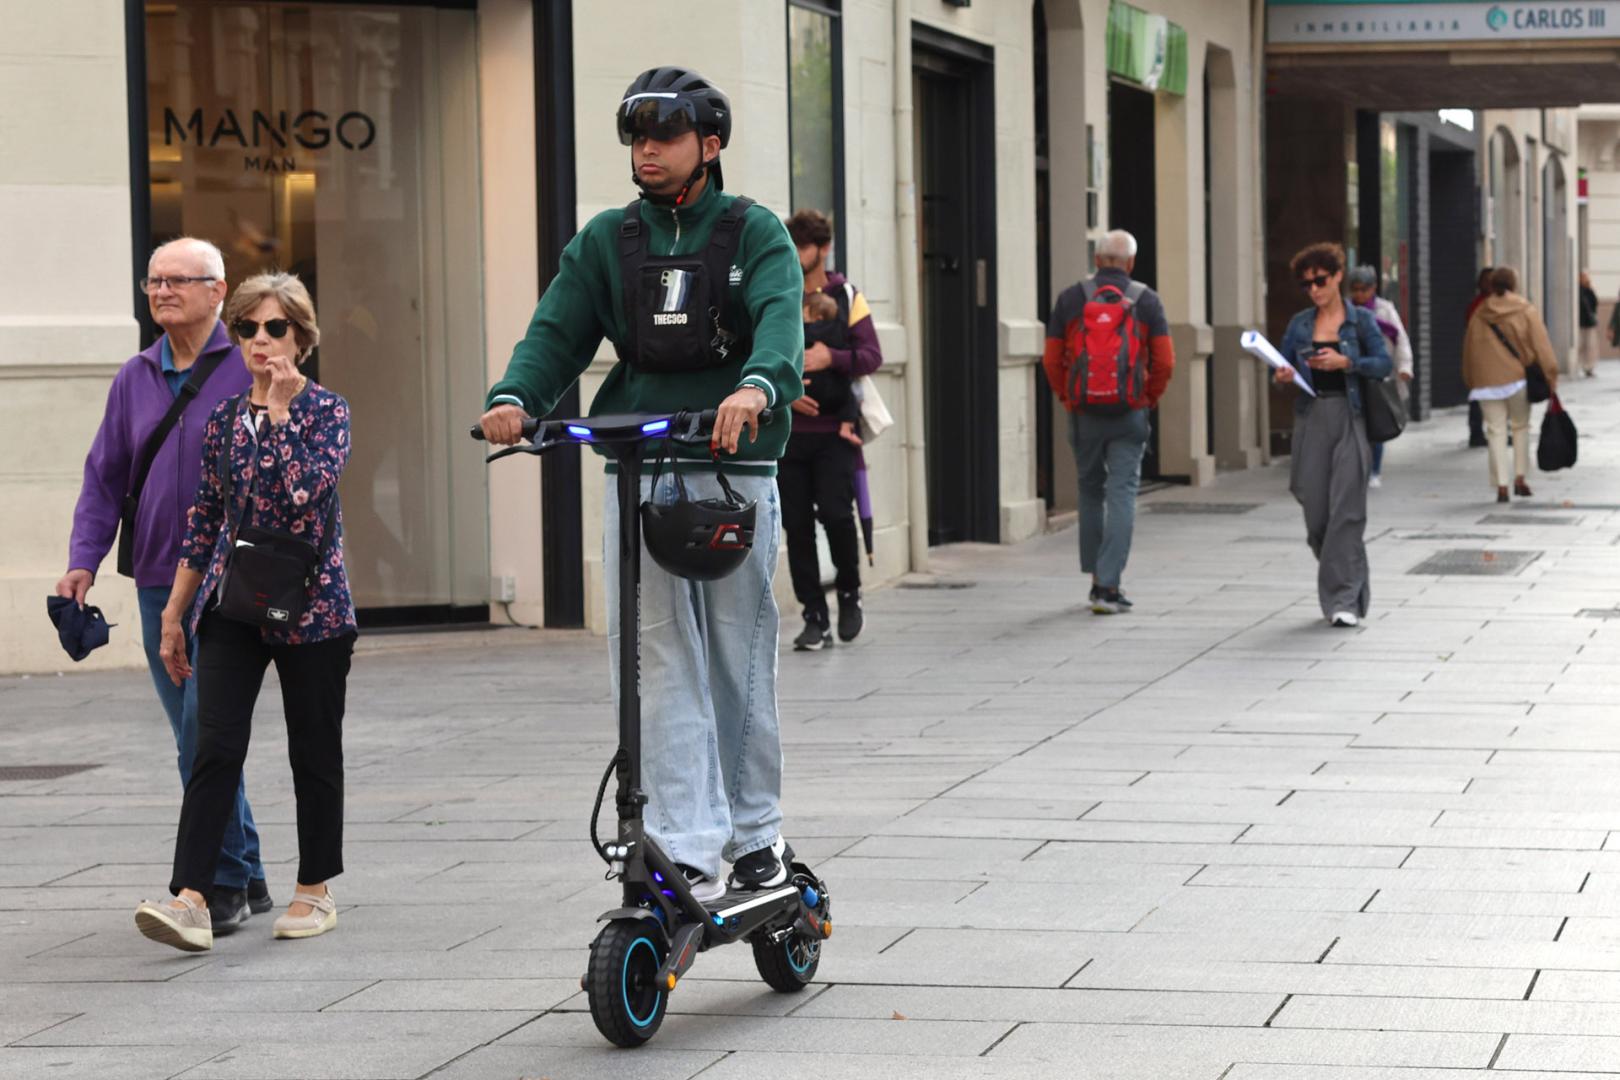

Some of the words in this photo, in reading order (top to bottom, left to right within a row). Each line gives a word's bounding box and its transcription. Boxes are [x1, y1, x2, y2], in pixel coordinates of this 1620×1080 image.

[1294, 20, 1460, 32] INMOBILIARIA
[1513, 8, 1583, 30] CARLOS
[1588, 8, 1606, 28] III
[163, 106, 377, 150] MANGO
[244, 156, 297, 172] MAN
